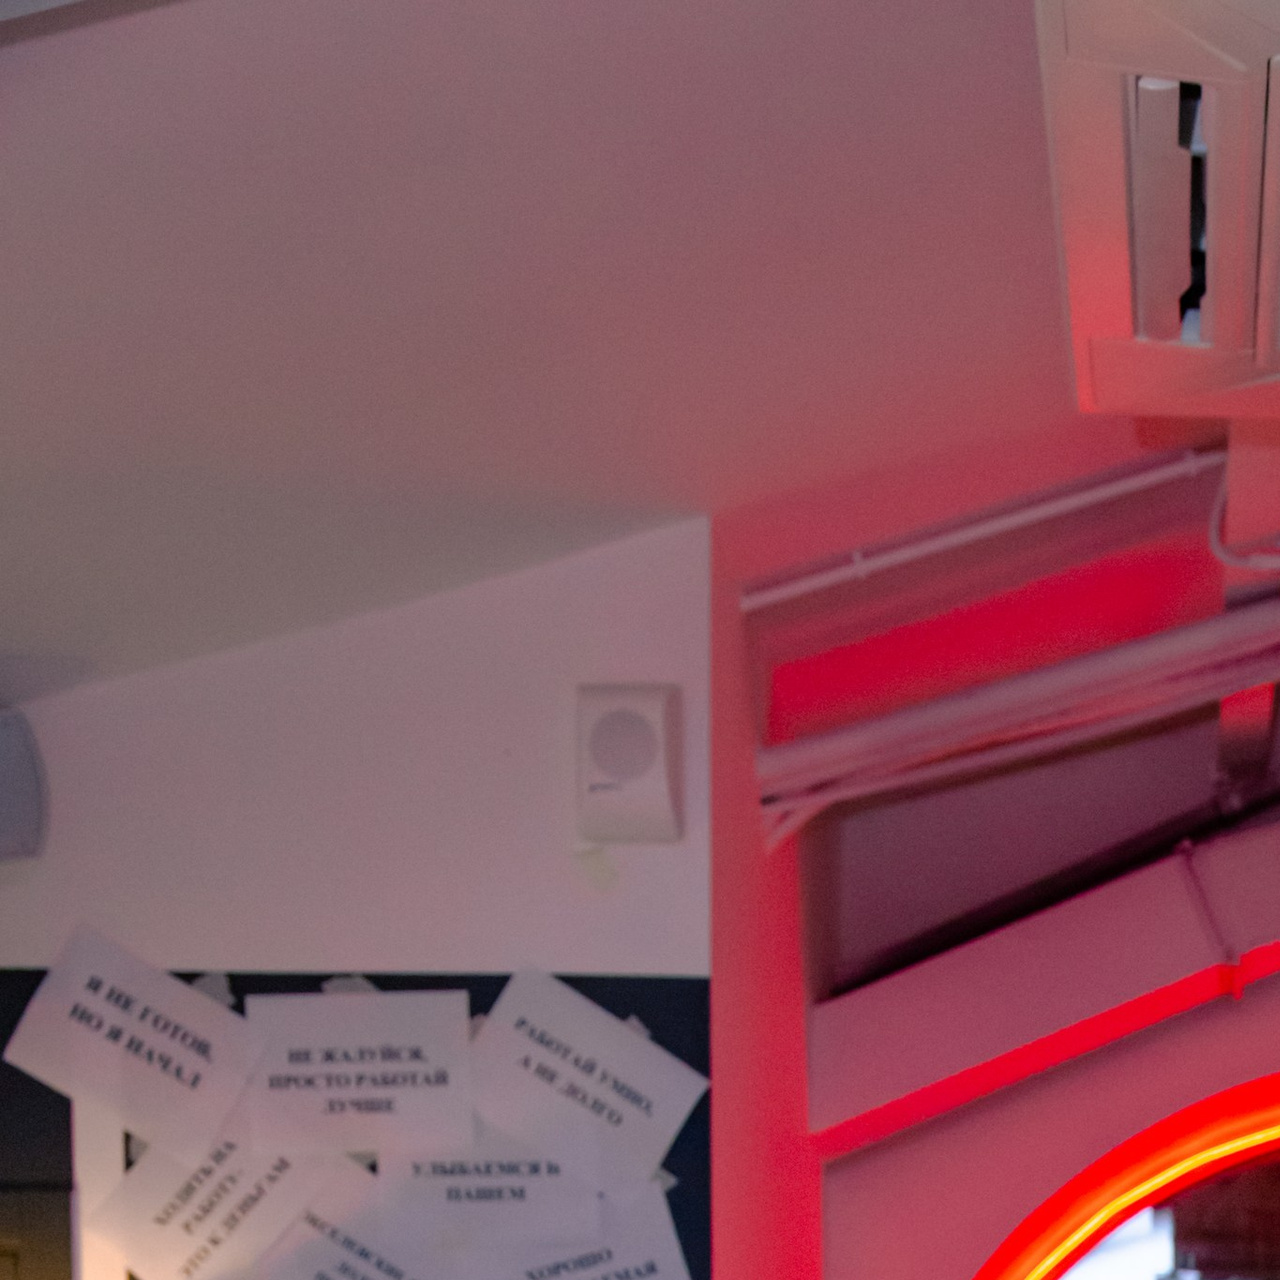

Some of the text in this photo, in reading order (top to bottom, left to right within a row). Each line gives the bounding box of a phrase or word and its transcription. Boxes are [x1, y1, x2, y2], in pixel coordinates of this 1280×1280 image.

[86, 976, 103, 993] Я
[106, 986, 133, 1012] НЕ
[69, 1003, 202, 1089] НО Я НАЧАЛ
[515, 1016, 596, 1075] РАБОТАЙ
[288, 1047, 311, 1064] НЕ
[268, 1068, 448, 1090] ПРОСТО РАБОТАЙ
[325, 1099, 394, 1114] ЛУЧШЕ
[412, 1160, 541, 1177] УЛЫБАЕМСЯ
[446, 1186, 526, 1201] ПАШЕМ
